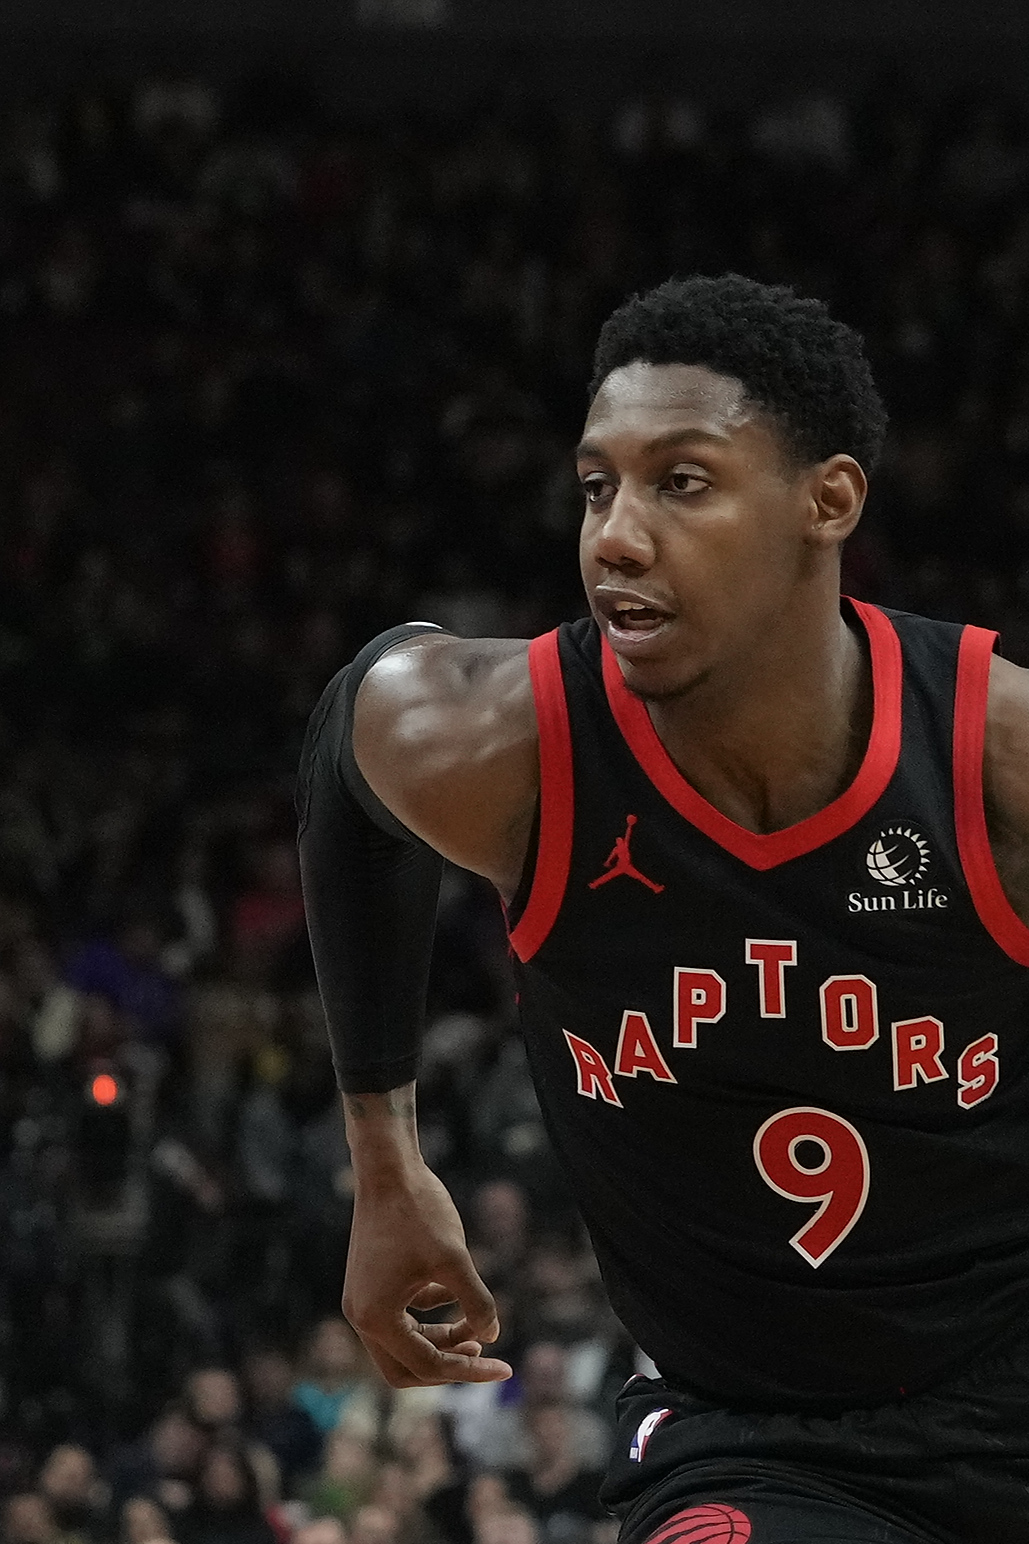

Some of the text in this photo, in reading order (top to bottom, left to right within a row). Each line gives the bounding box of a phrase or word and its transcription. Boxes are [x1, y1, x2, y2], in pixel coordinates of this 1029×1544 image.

[848, 888, 948, 912] Sun Life
[562, 937, 999, 1110] RAPTORS
[753, 1106, 870, 1269] 9
